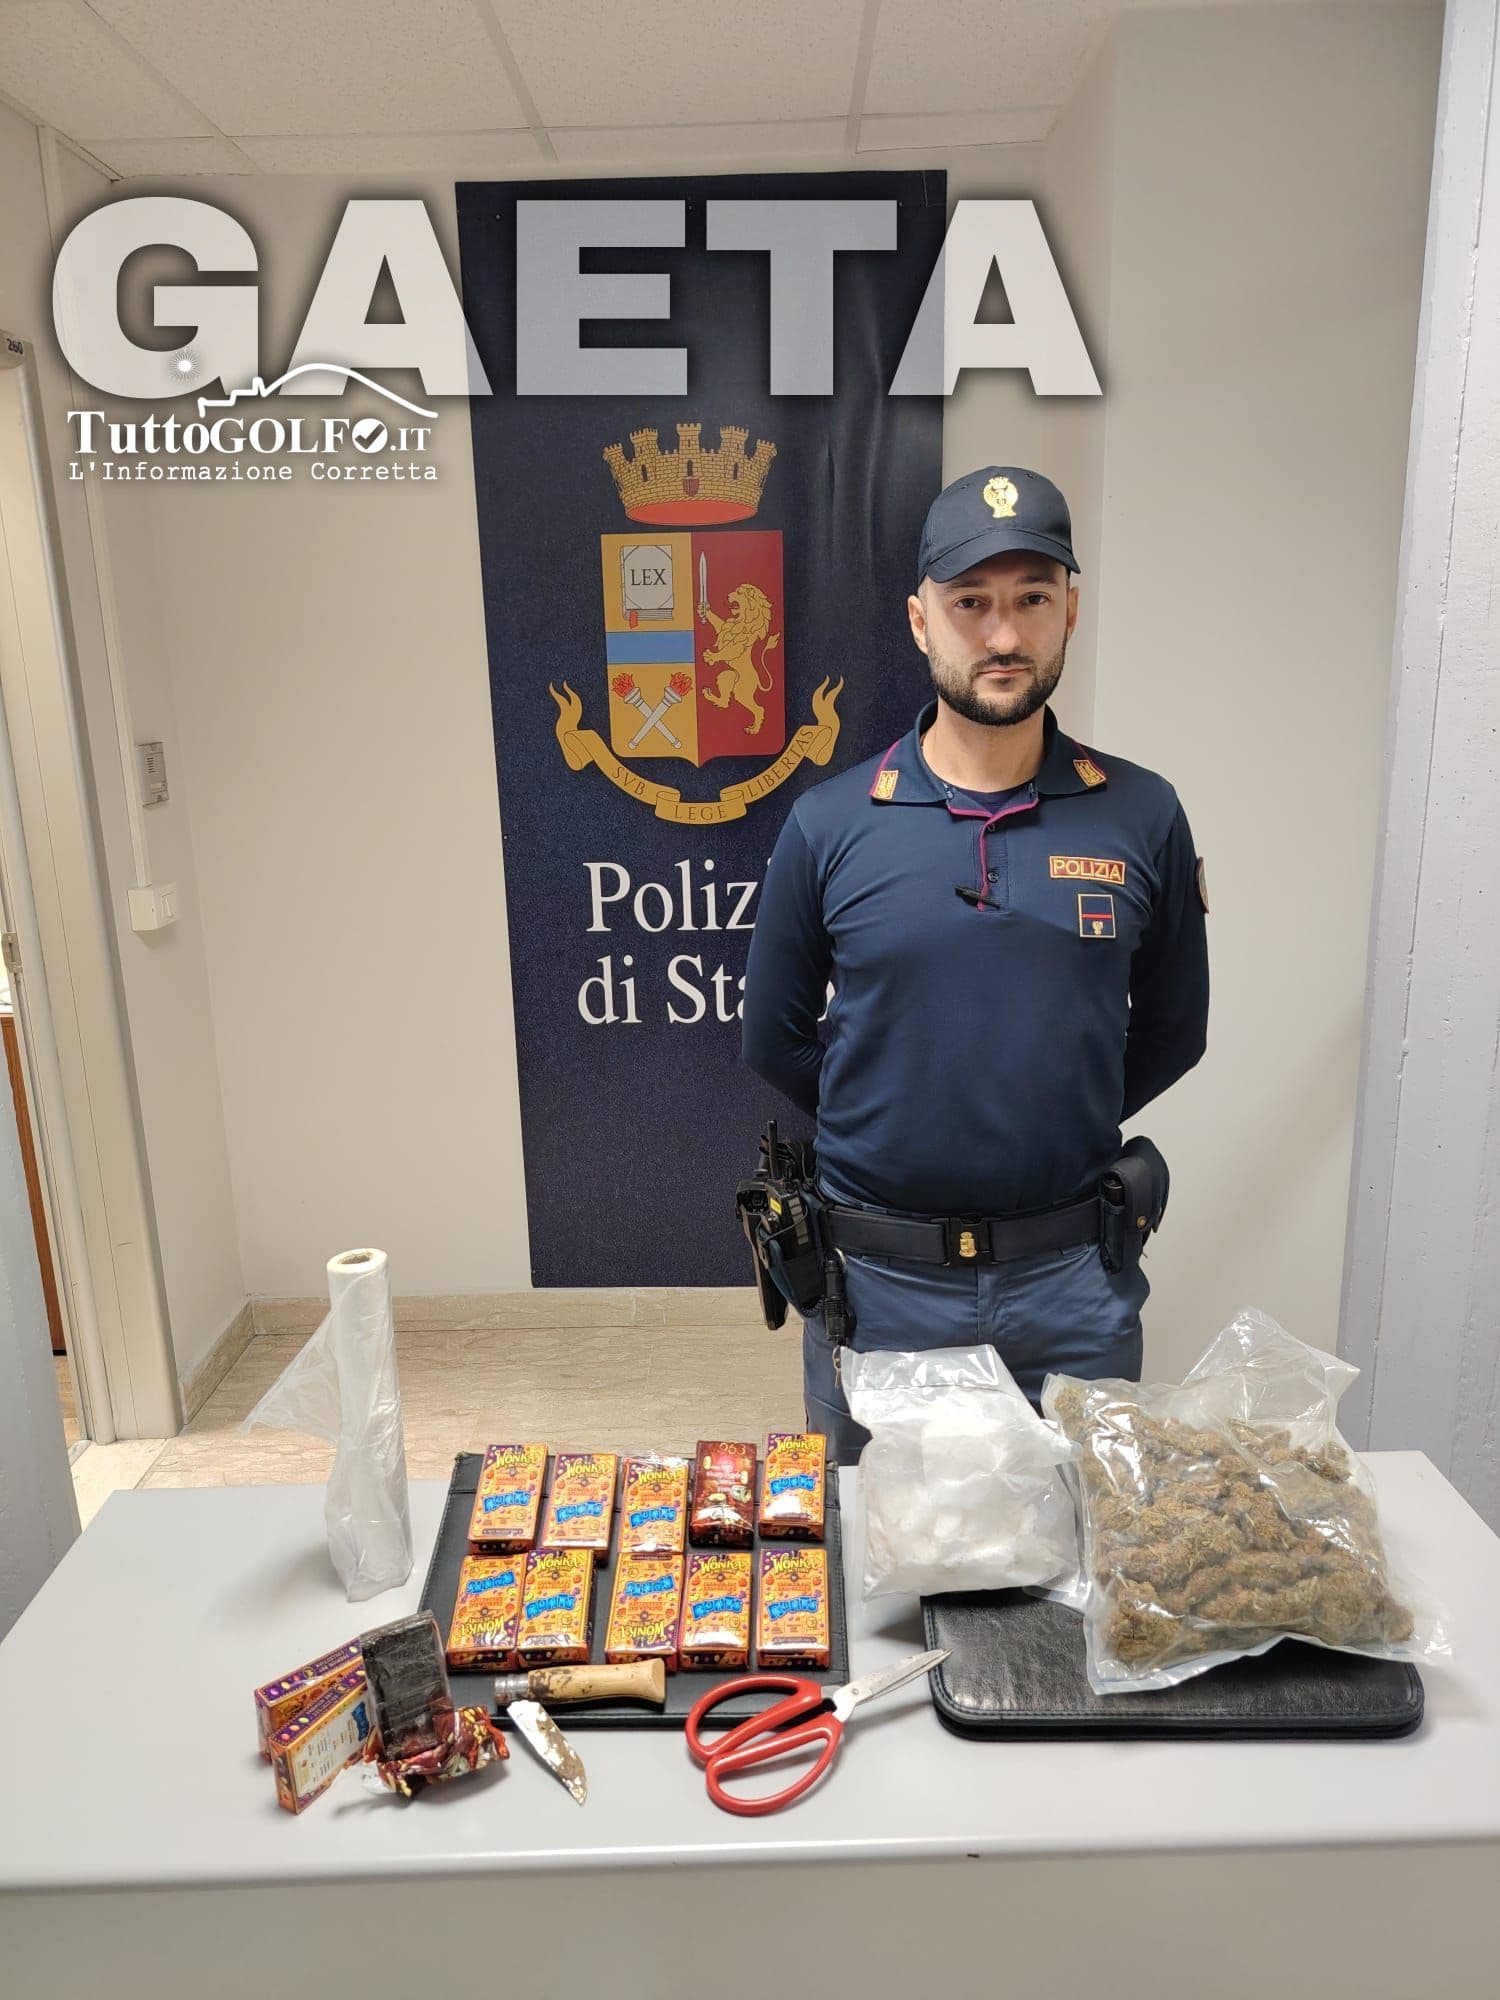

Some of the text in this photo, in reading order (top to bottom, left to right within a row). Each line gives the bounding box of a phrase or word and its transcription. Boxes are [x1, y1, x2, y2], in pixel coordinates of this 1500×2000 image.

[630, 568, 667, 586] LEX
[746, 727, 815, 798] LIBERTAS
[612, 766, 646, 796] SVB
[674, 804, 728, 821] LEGE
[1053, 859, 1121, 881] POLIZIA
[582, 858, 772, 933] Poliz
[577, 955, 643, 1025] di
